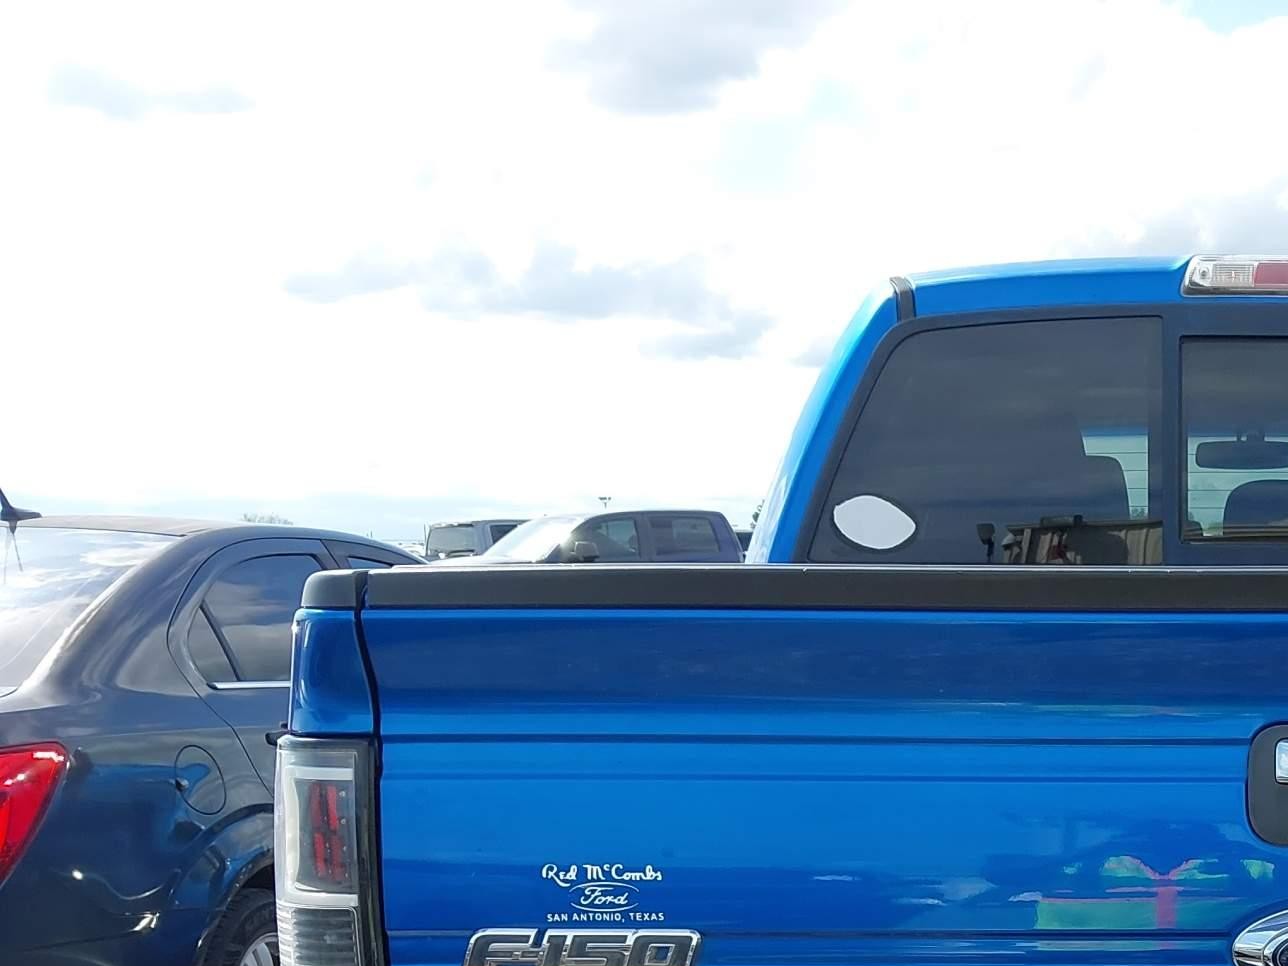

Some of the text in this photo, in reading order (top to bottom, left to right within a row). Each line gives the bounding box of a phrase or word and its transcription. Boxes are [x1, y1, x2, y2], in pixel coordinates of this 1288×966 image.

[541, 863, 663, 887] Red McCombs
[580, 886, 629, 905] Ford
[547, 912, 665, 923] SAN ANTONIO, TEXAS
